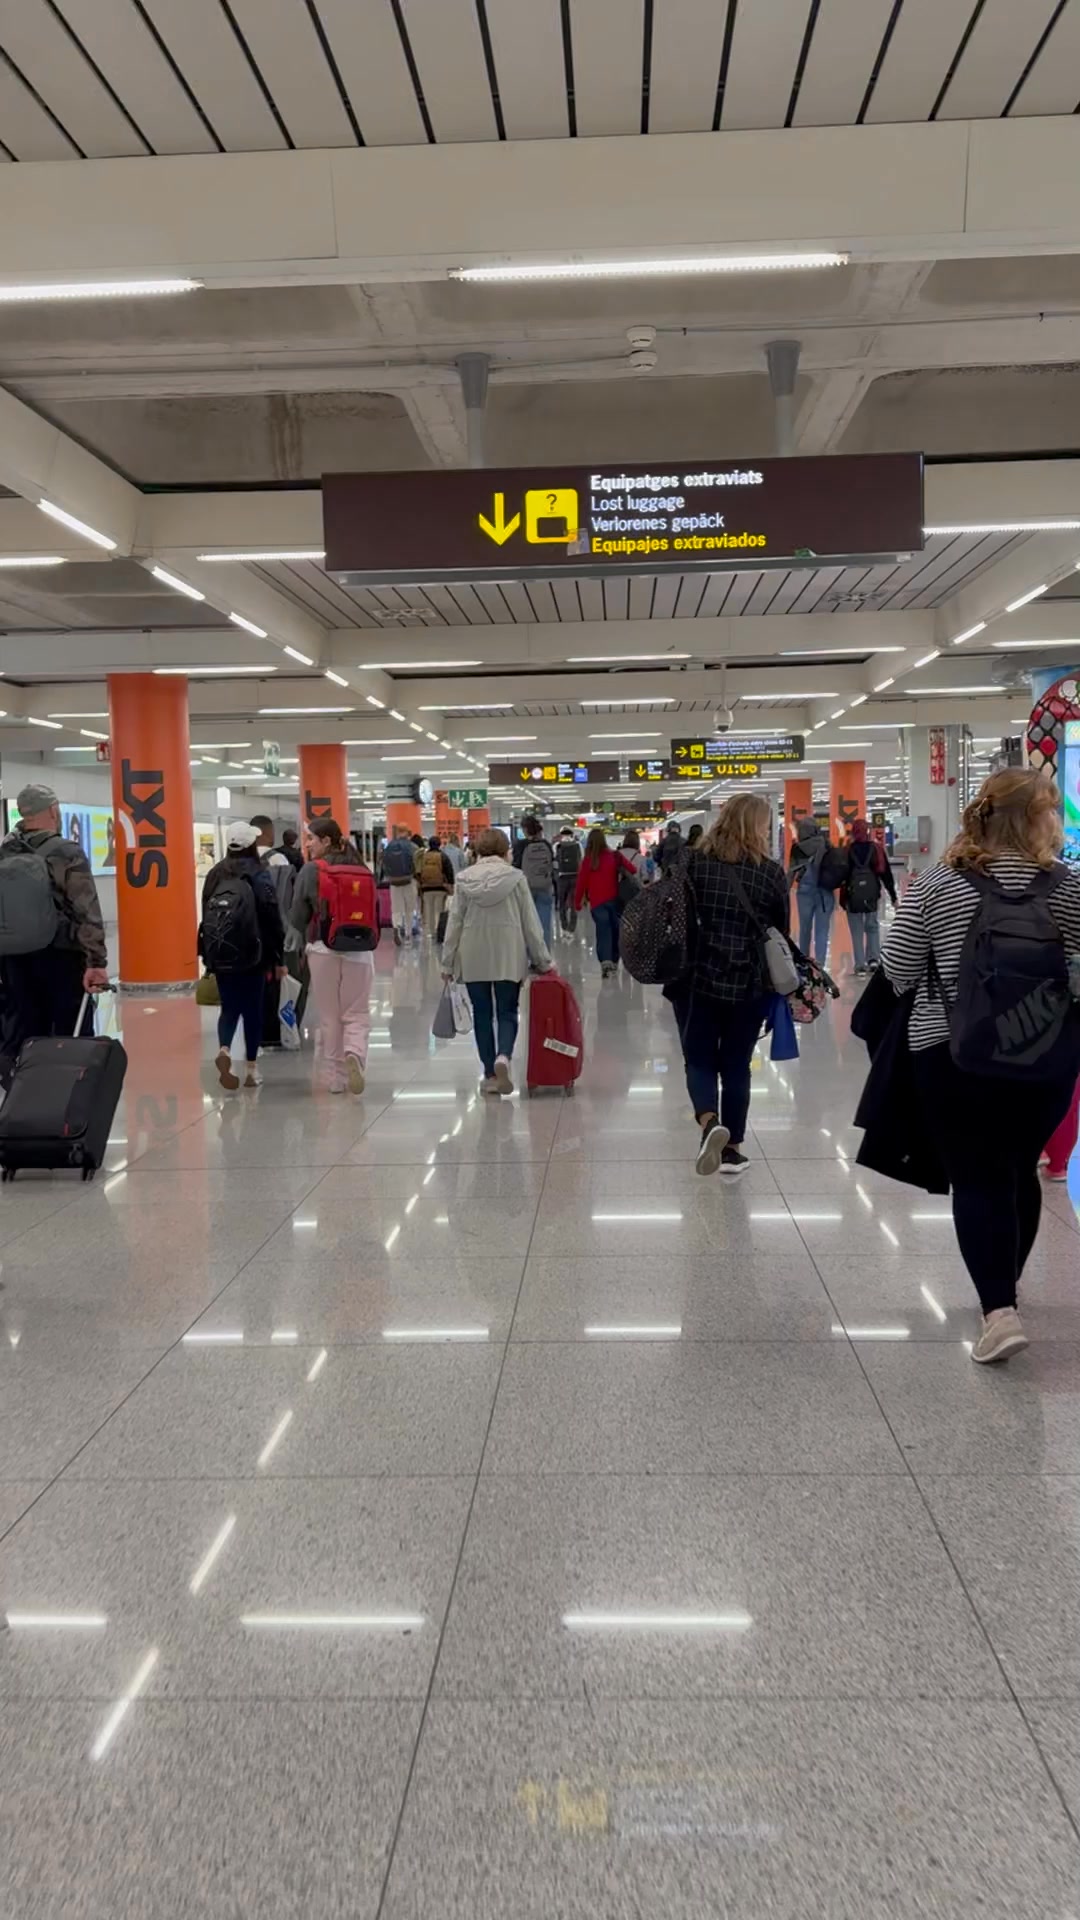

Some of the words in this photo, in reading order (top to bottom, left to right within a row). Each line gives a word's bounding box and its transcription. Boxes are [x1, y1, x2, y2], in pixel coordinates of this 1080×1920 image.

[590, 474, 680, 492] Equipatges
[683, 470, 764, 487] extraviats
[591, 495, 623, 511] Lost
[627, 494, 685, 512] luggage
[591, 515, 667, 532] Verlorenes
[672, 513, 725, 532] gepäck
[592, 535, 668, 555] Equipajes
[674, 532, 766, 550] extraviados
[121, 759, 169, 888] SIXT
